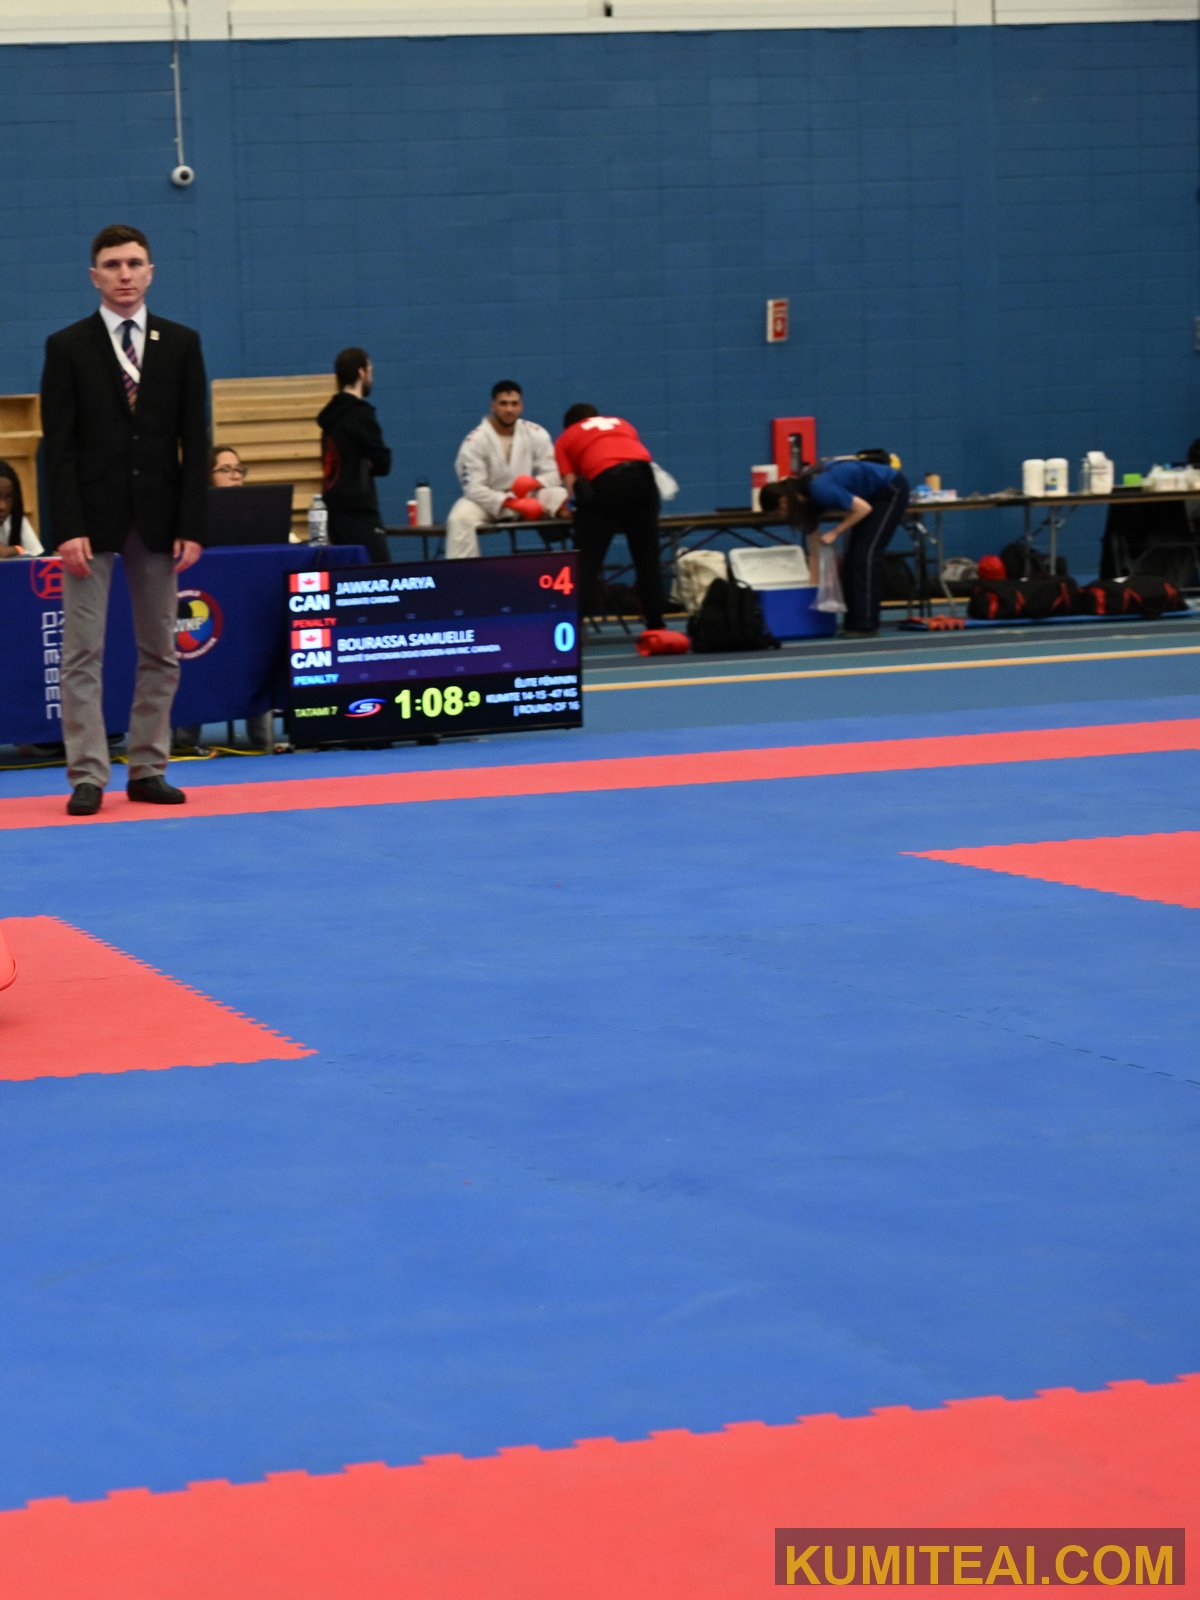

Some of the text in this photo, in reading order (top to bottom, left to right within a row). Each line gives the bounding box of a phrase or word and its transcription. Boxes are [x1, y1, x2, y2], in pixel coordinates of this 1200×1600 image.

[335, 576, 436, 595] JAWKAR AARYA
[289, 594, 331, 612] CAN
[292, 617, 337, 628] PENALTY
[337, 629, 475, 652] BOURASSA SAMUELLE
[554, 622, 576, 652] 0
[291, 651, 332, 669] CAN
[293, 673, 340, 686] PENALTY
[394, 686, 481, 719] 1:08.9
[519, 703, 553, 714] ROUND
[553, 702, 567, 712] OF
[568, 701, 580, 710] 16
[294, 706, 338, 718] TATAMI 7
